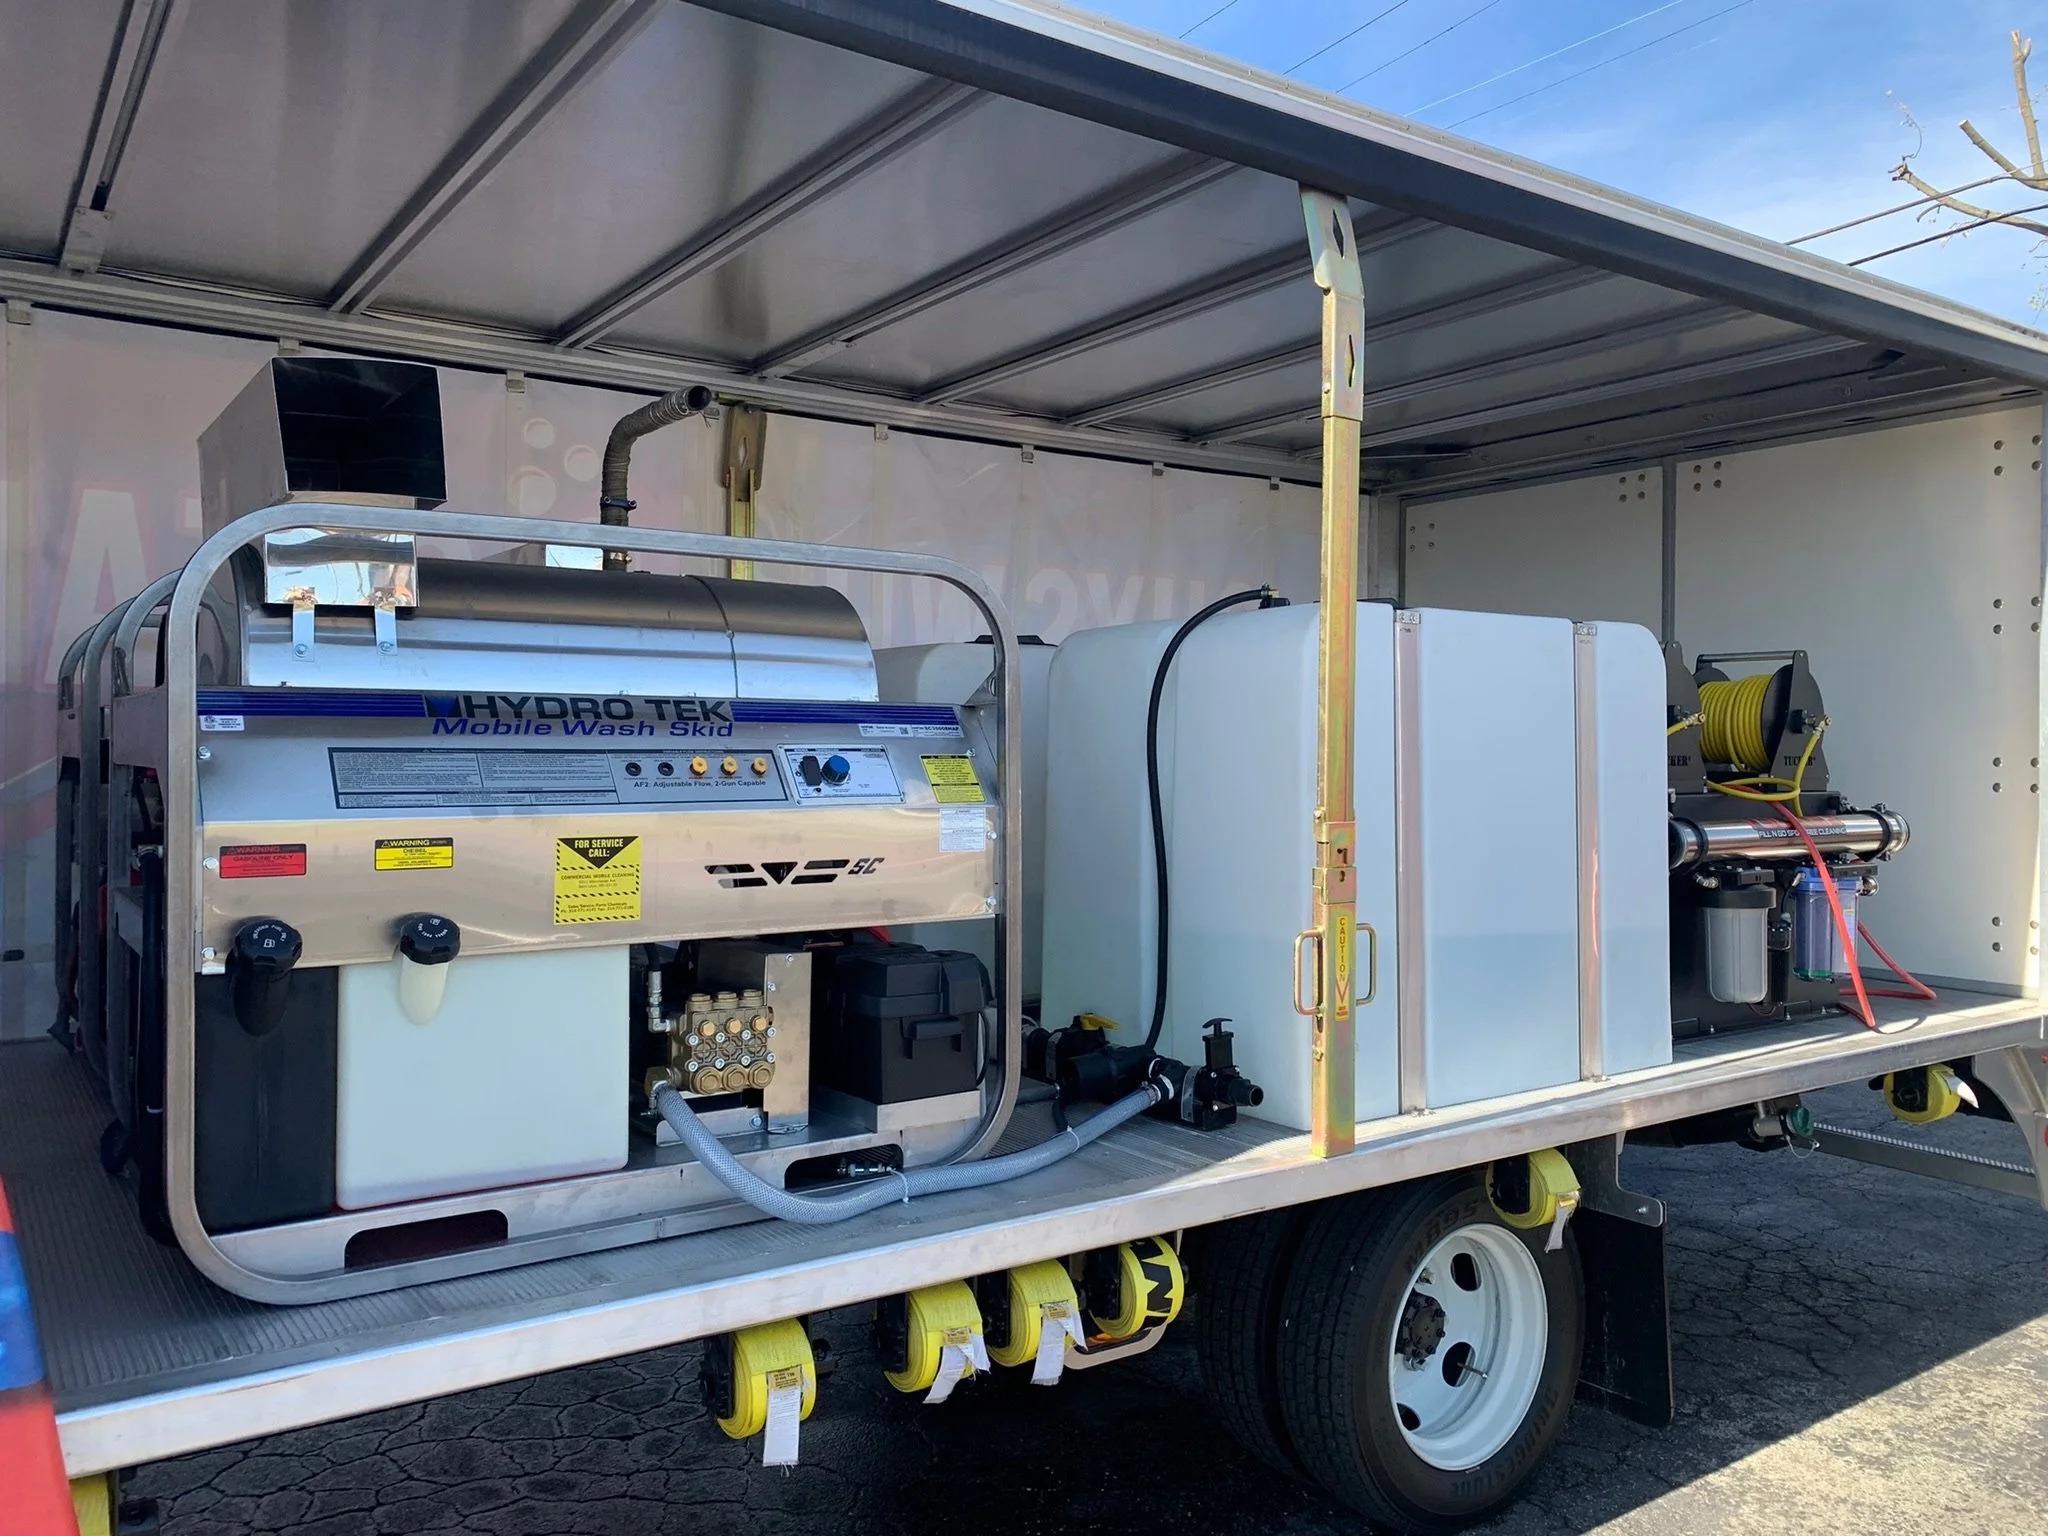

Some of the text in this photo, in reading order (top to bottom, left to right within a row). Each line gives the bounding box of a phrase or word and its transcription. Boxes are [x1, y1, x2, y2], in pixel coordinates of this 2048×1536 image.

[464, 695, 732, 722] HYDRO TEK
[432, 718, 733, 737] Mobile Wash Skid
[1758, 830, 1772, 838] FILL
[1818, 825, 1847, 835] CLEANING
[389, 839, 430, 847] WARNING
[574, 838, 624, 849] FOR SERVICE
[236, 846, 281, 854] WARNING
[588, 848, 610, 857] CALL:
